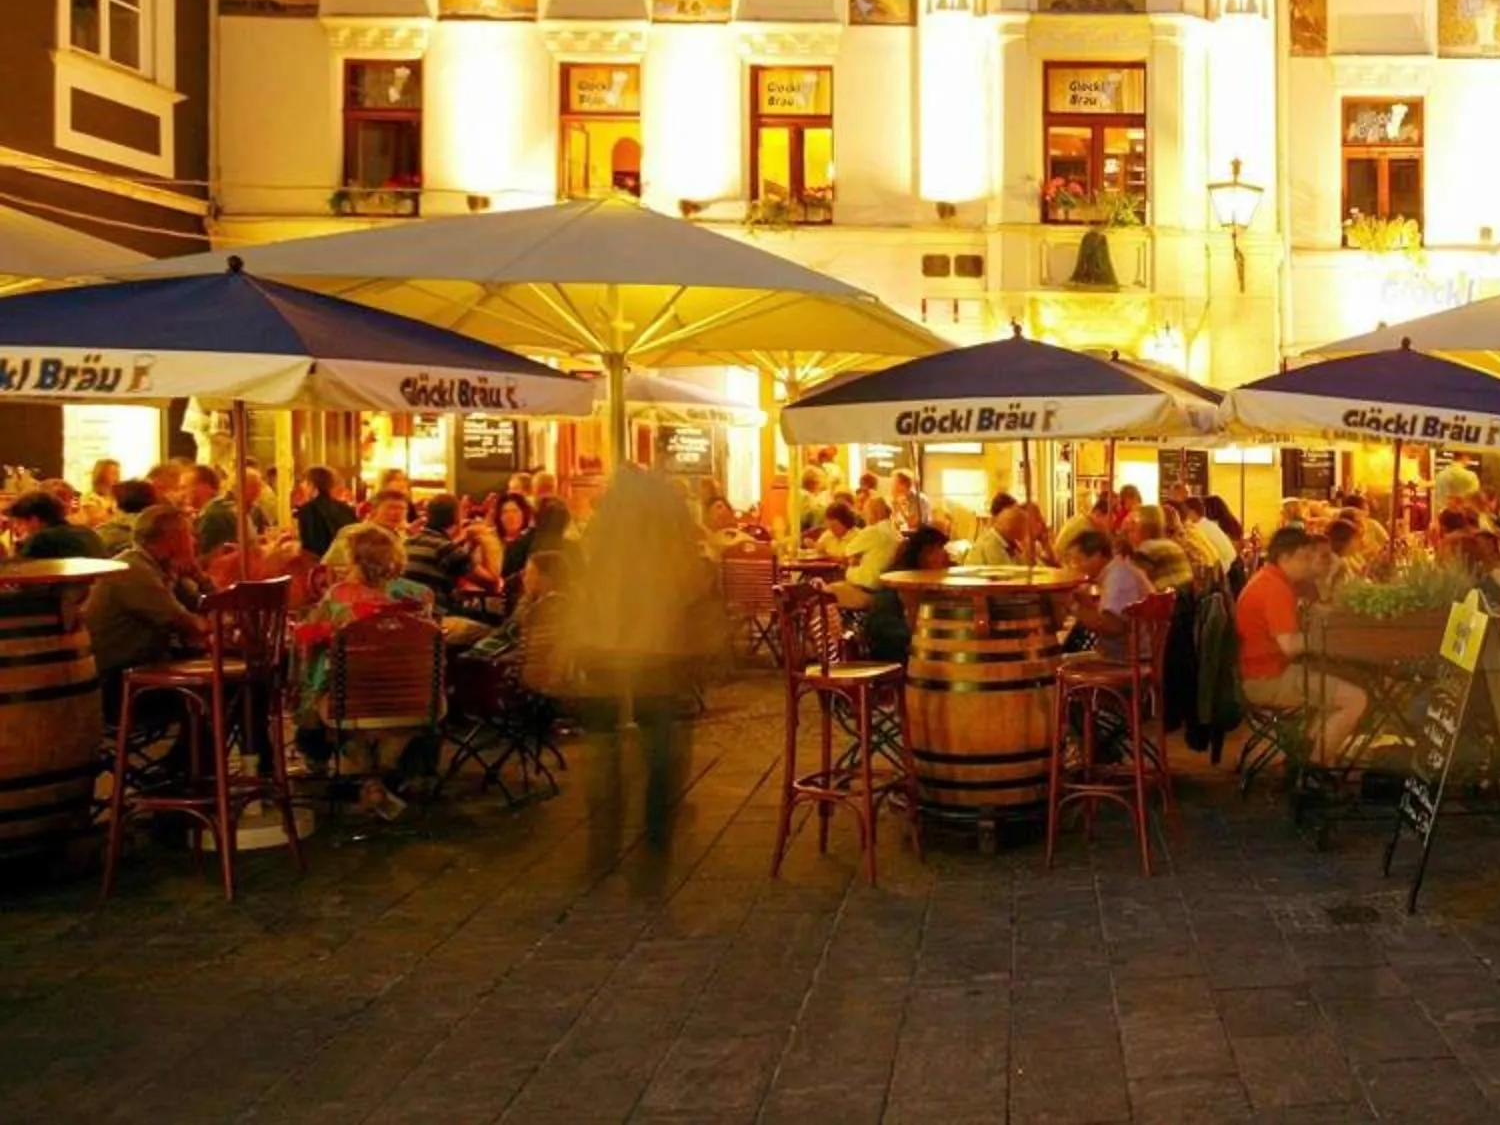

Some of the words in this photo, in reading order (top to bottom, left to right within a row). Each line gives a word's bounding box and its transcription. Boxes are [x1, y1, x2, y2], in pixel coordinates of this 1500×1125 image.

[35, 355, 123, 393] Bräu
[458, 377, 504, 410] Bräu
[896, 406, 973, 436] Glöckl
[976, 403, 1036, 433] Bräu
[1342, 408, 1418, 437] Glöckl
[1419, 415, 1480, 446] Bräu
